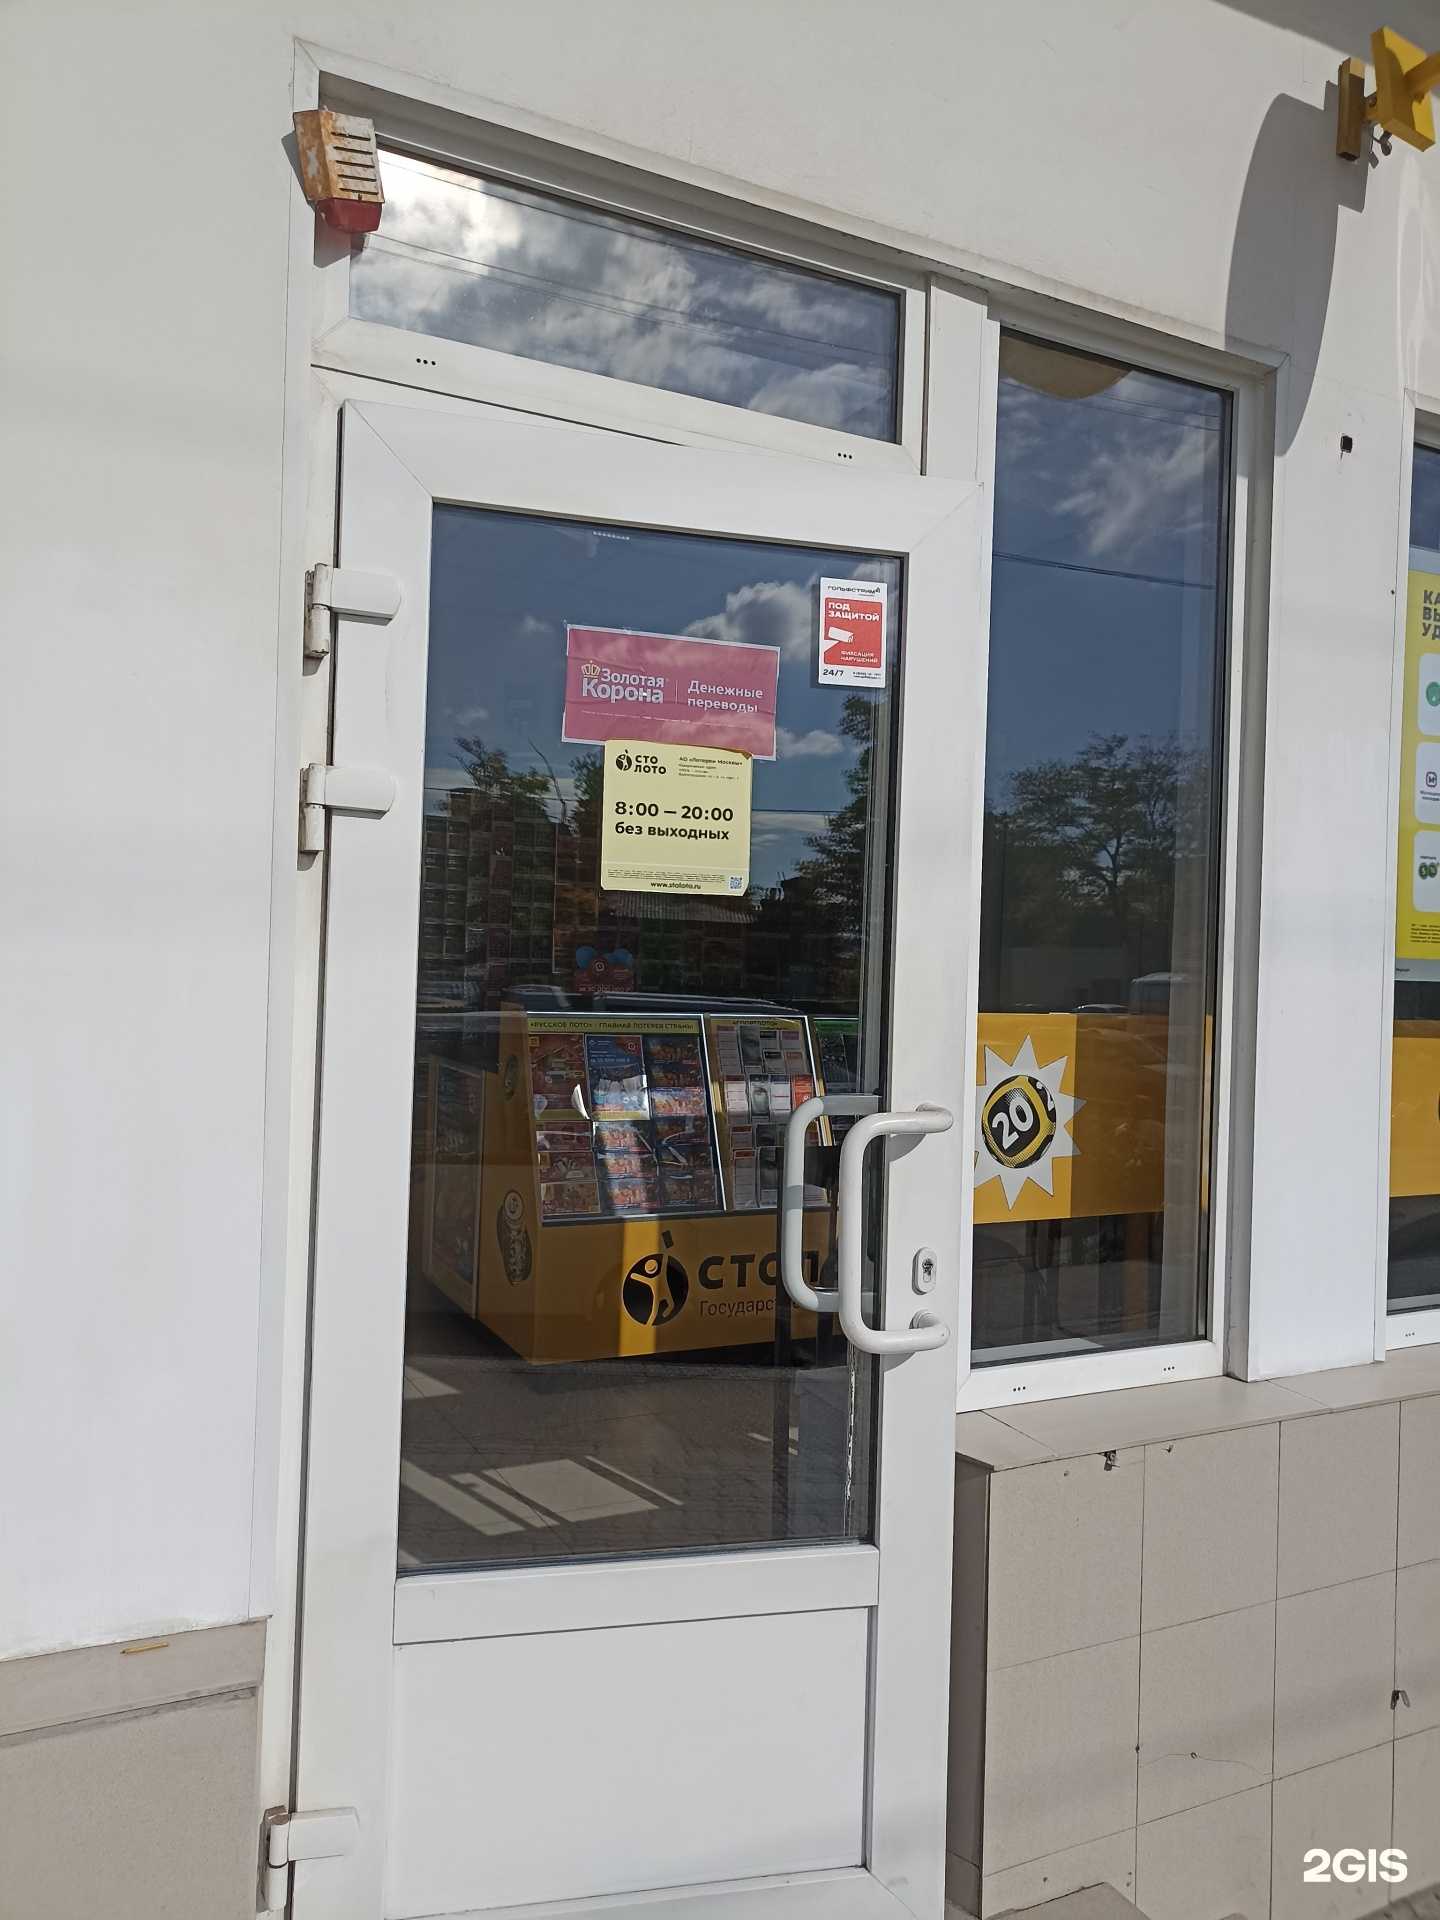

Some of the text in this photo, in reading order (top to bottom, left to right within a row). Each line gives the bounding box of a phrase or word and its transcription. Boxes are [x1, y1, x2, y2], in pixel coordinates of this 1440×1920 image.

[828, 601, 850, 611] ПОД
[828, 610, 880, 622] ЗАЩИТОЙ
[601, 668, 665, 688] Золотая
[823, 668, 845, 677] 24/7
[582, 678, 664, 704] Корона
[688, 680, 764, 699] Денежные
[688, 697, 758, 713] переводы
[634, 754, 658, 764] СТО
[633, 764, 667, 775] ЛОТО
[615, 801, 659, 817] 8:00
[681, 805, 734, 822] 20:00
[615, 822, 730, 840] без выходных
[651, 882, 701, 890] www.stoloto.ru
[992, 1097, 1034, 1150] 20
